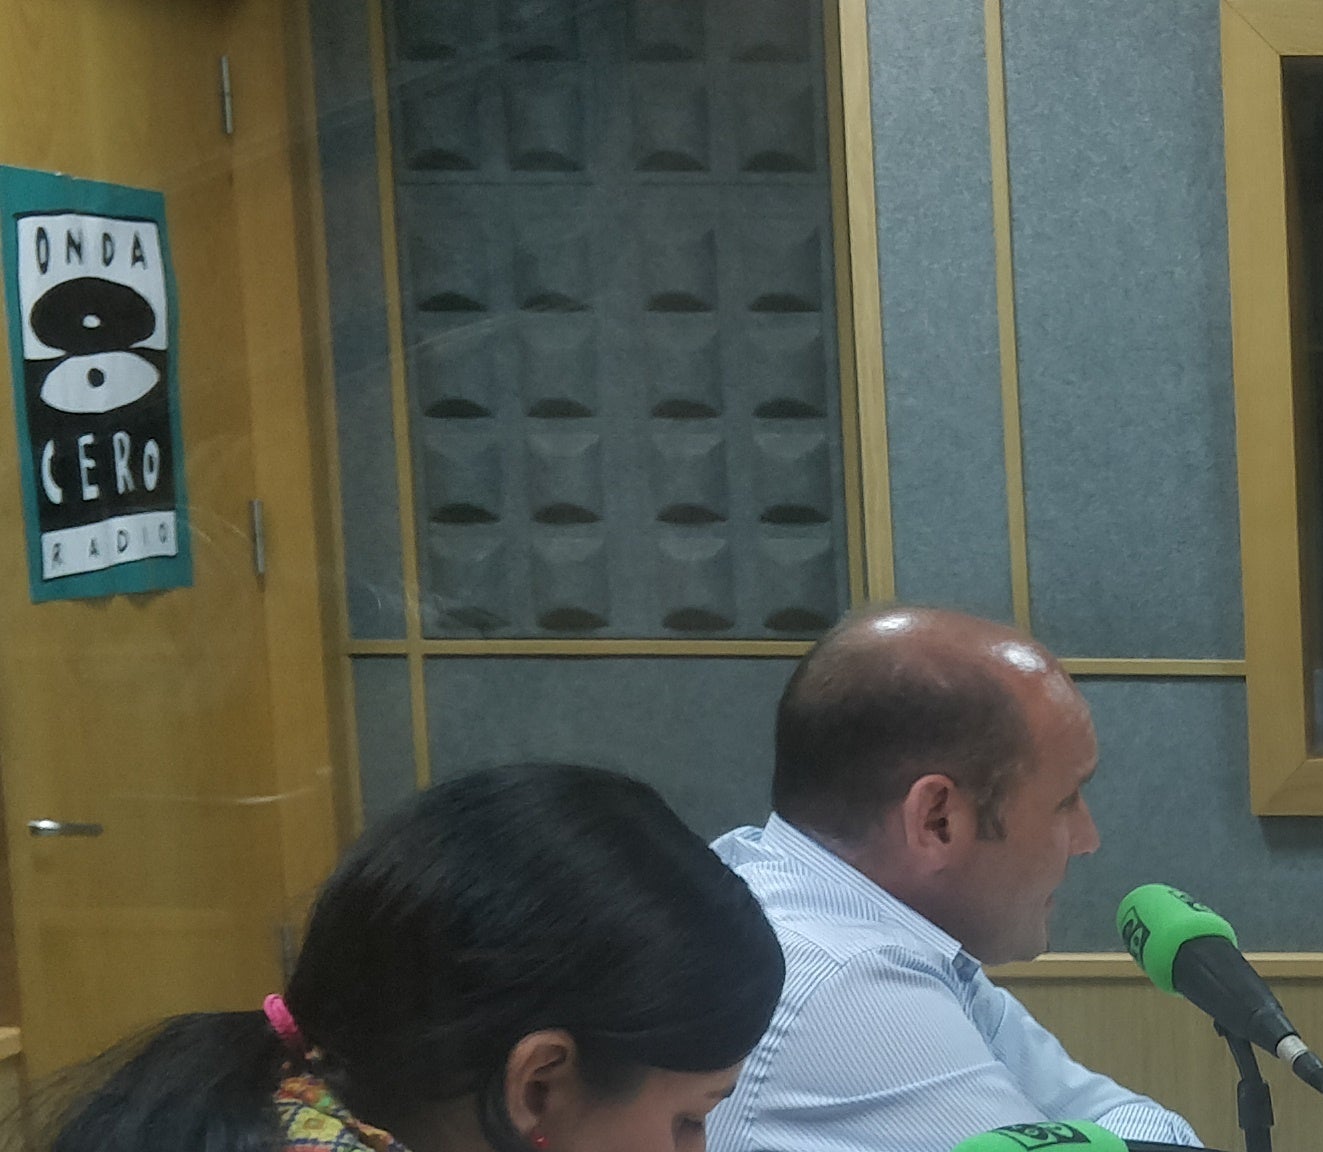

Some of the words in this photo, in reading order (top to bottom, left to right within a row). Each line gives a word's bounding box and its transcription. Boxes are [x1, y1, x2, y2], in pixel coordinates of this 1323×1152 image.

[36, 225, 147, 274] ONDA
[40, 431, 161, 505] CERO
[49, 523, 169, 568] RADIO
